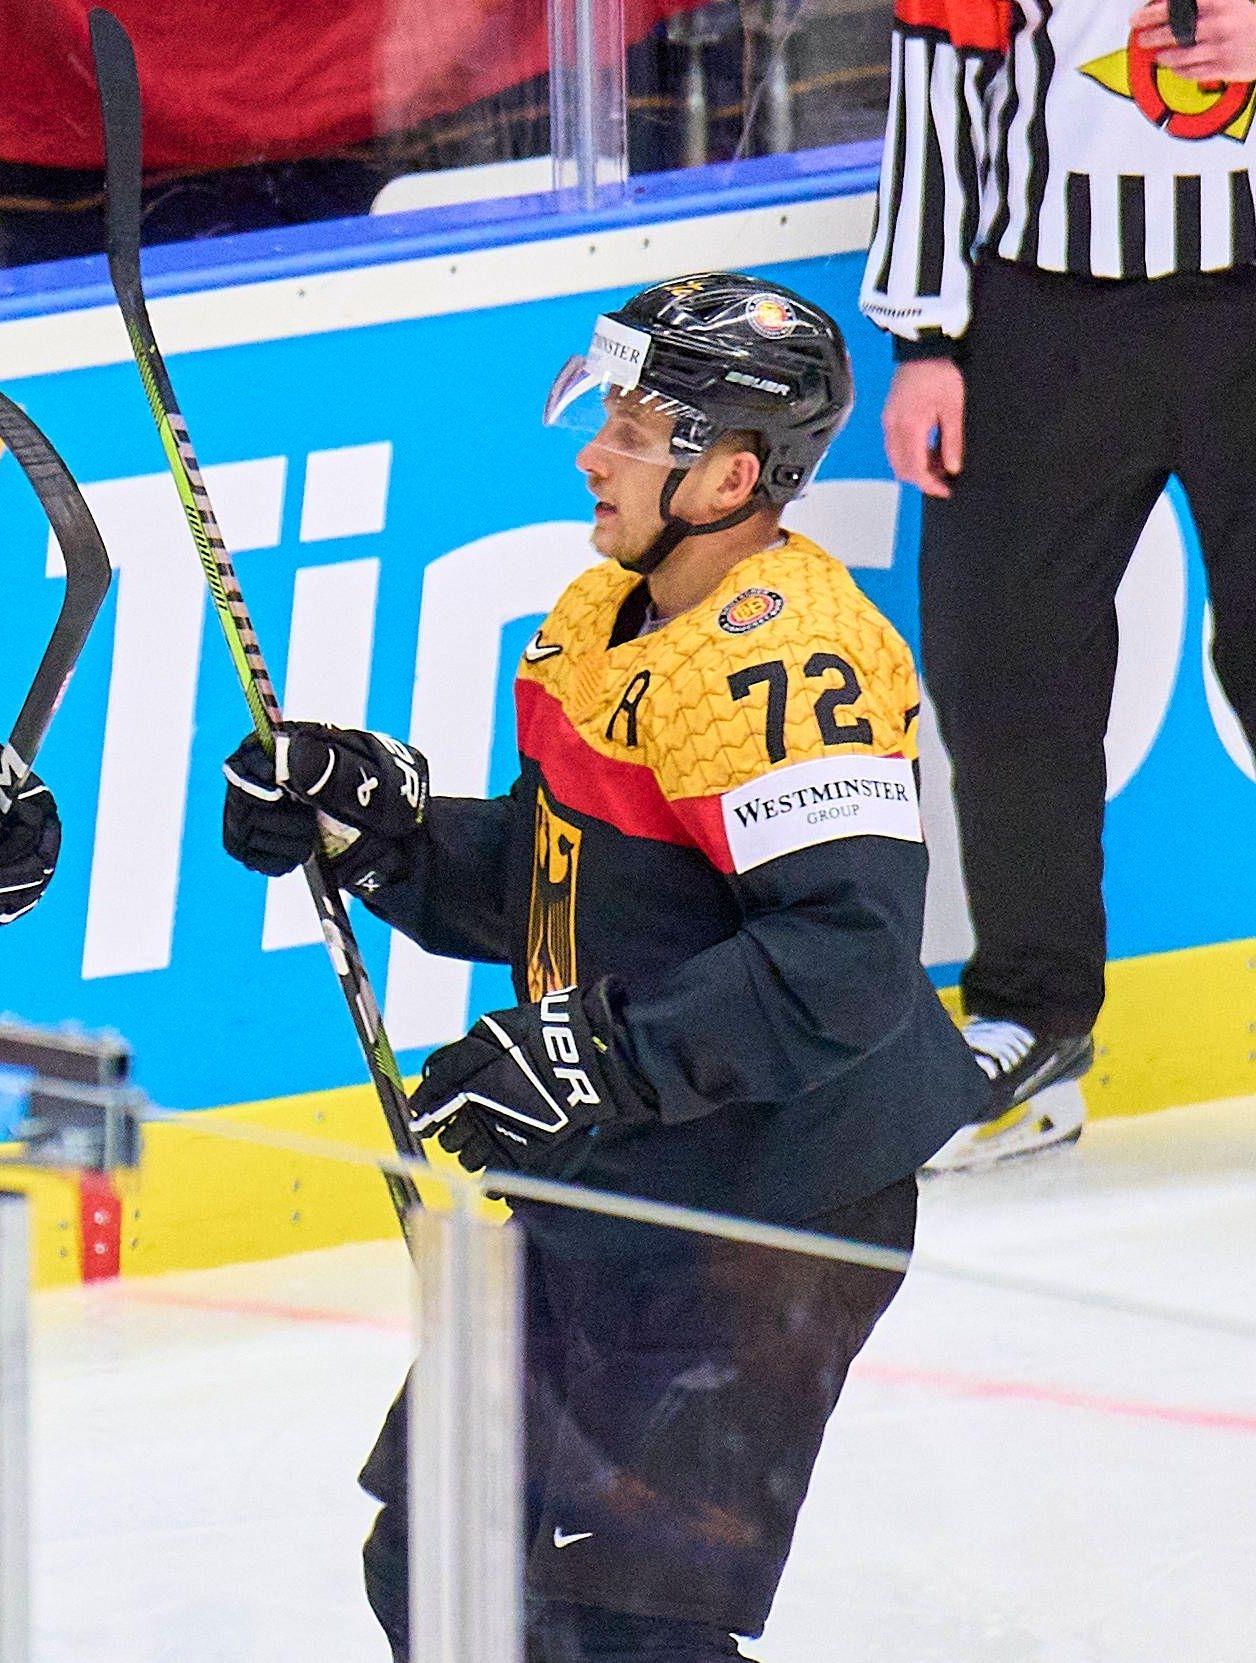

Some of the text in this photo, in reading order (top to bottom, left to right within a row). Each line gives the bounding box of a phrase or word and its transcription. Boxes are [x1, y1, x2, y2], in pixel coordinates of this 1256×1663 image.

[605, 669, 650, 746] A
[727, 653, 873, 764] 72
[734, 779, 909, 828] WESTMINSTER
[807, 804, 860, 824] GROUP
[541, 984, 601, 1107] UER
